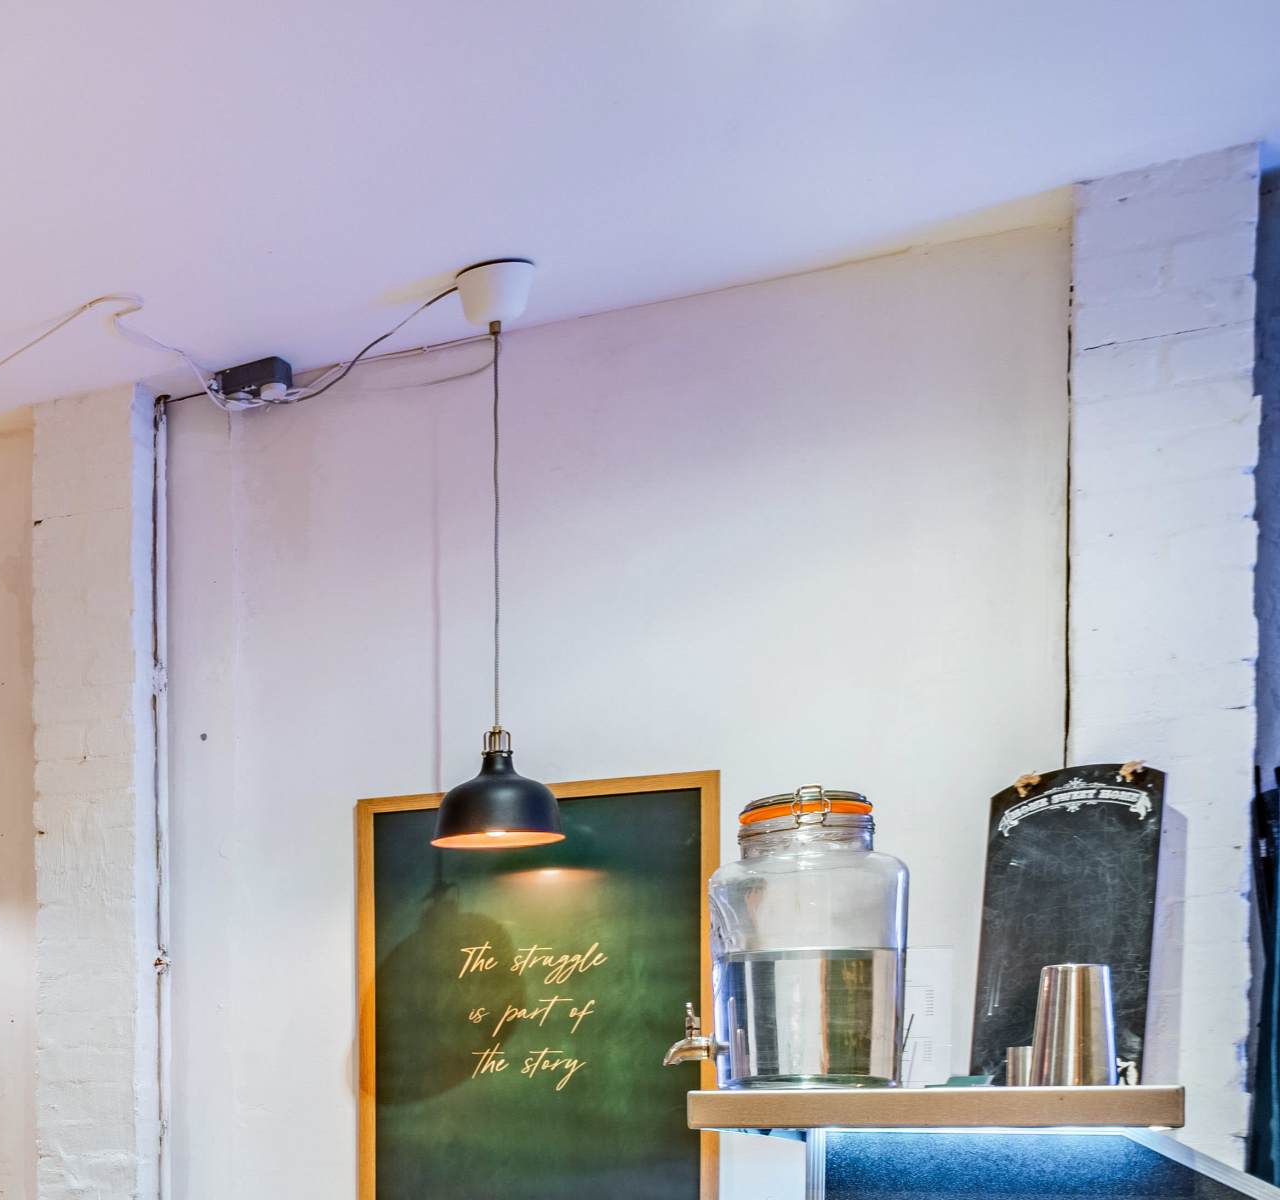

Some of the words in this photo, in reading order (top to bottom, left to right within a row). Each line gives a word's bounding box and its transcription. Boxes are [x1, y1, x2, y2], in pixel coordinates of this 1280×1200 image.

[458, 941, 498, 979] The
[510, 942, 608, 984] struggle
[468, 1007, 489, 1024] is
[492, 995, 573, 1038] part
[569, 1000, 595, 1034] of
[471, 1042, 509, 1079] the
[521, 1047, 587, 1091] story
